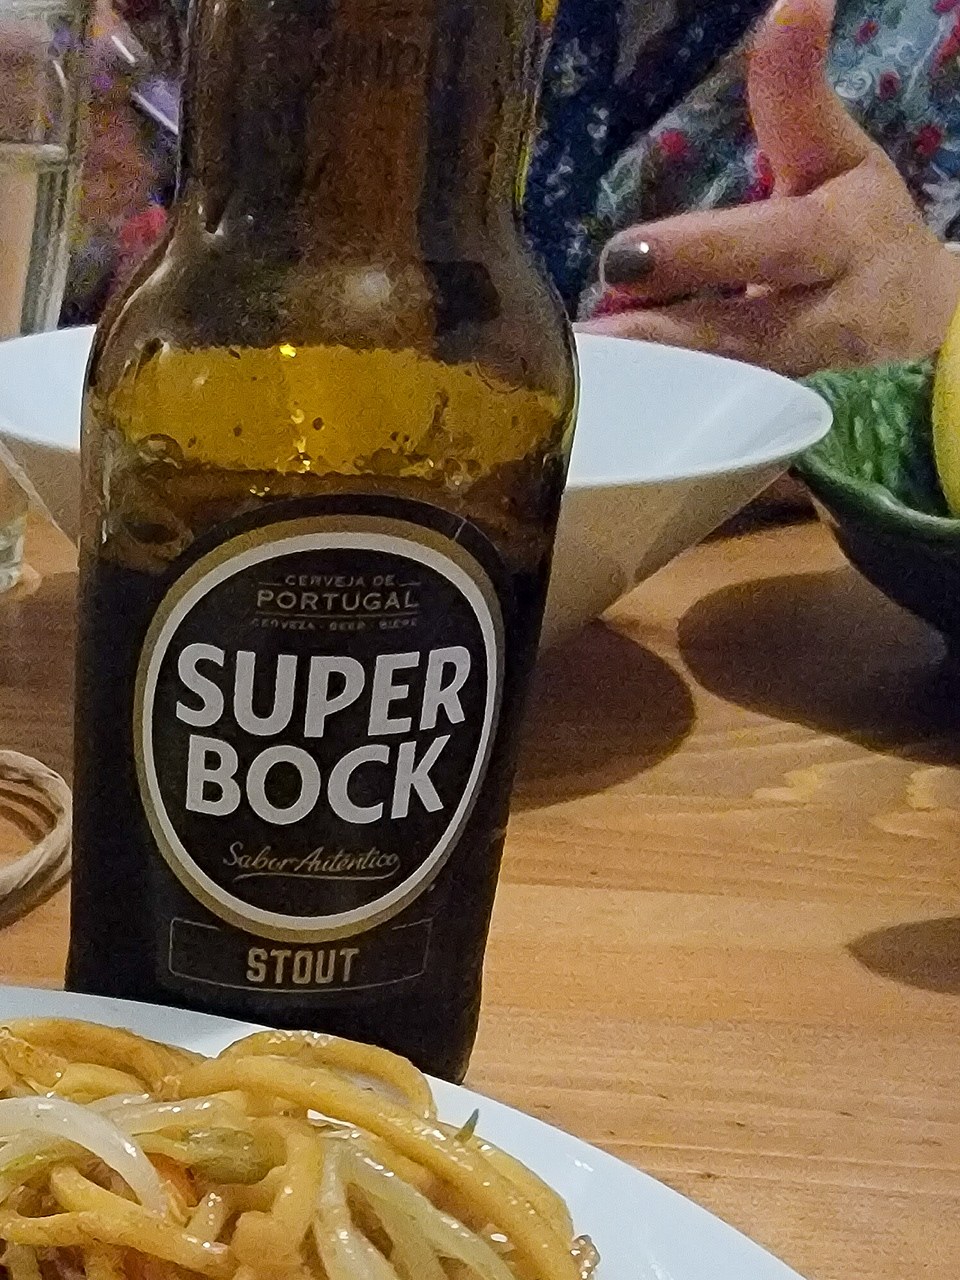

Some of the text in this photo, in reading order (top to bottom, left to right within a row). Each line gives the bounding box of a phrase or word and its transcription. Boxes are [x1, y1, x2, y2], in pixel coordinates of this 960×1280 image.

[285, 574, 396, 587] CERVEJA DE
[256, 589, 419, 611] PORTUGAL
[176, 642, 471, 738] SUPER
[185, 735, 452, 825] BOCK
[223, 841, 299, 871] Sabor
[246, 946, 360, 984] STOUT
